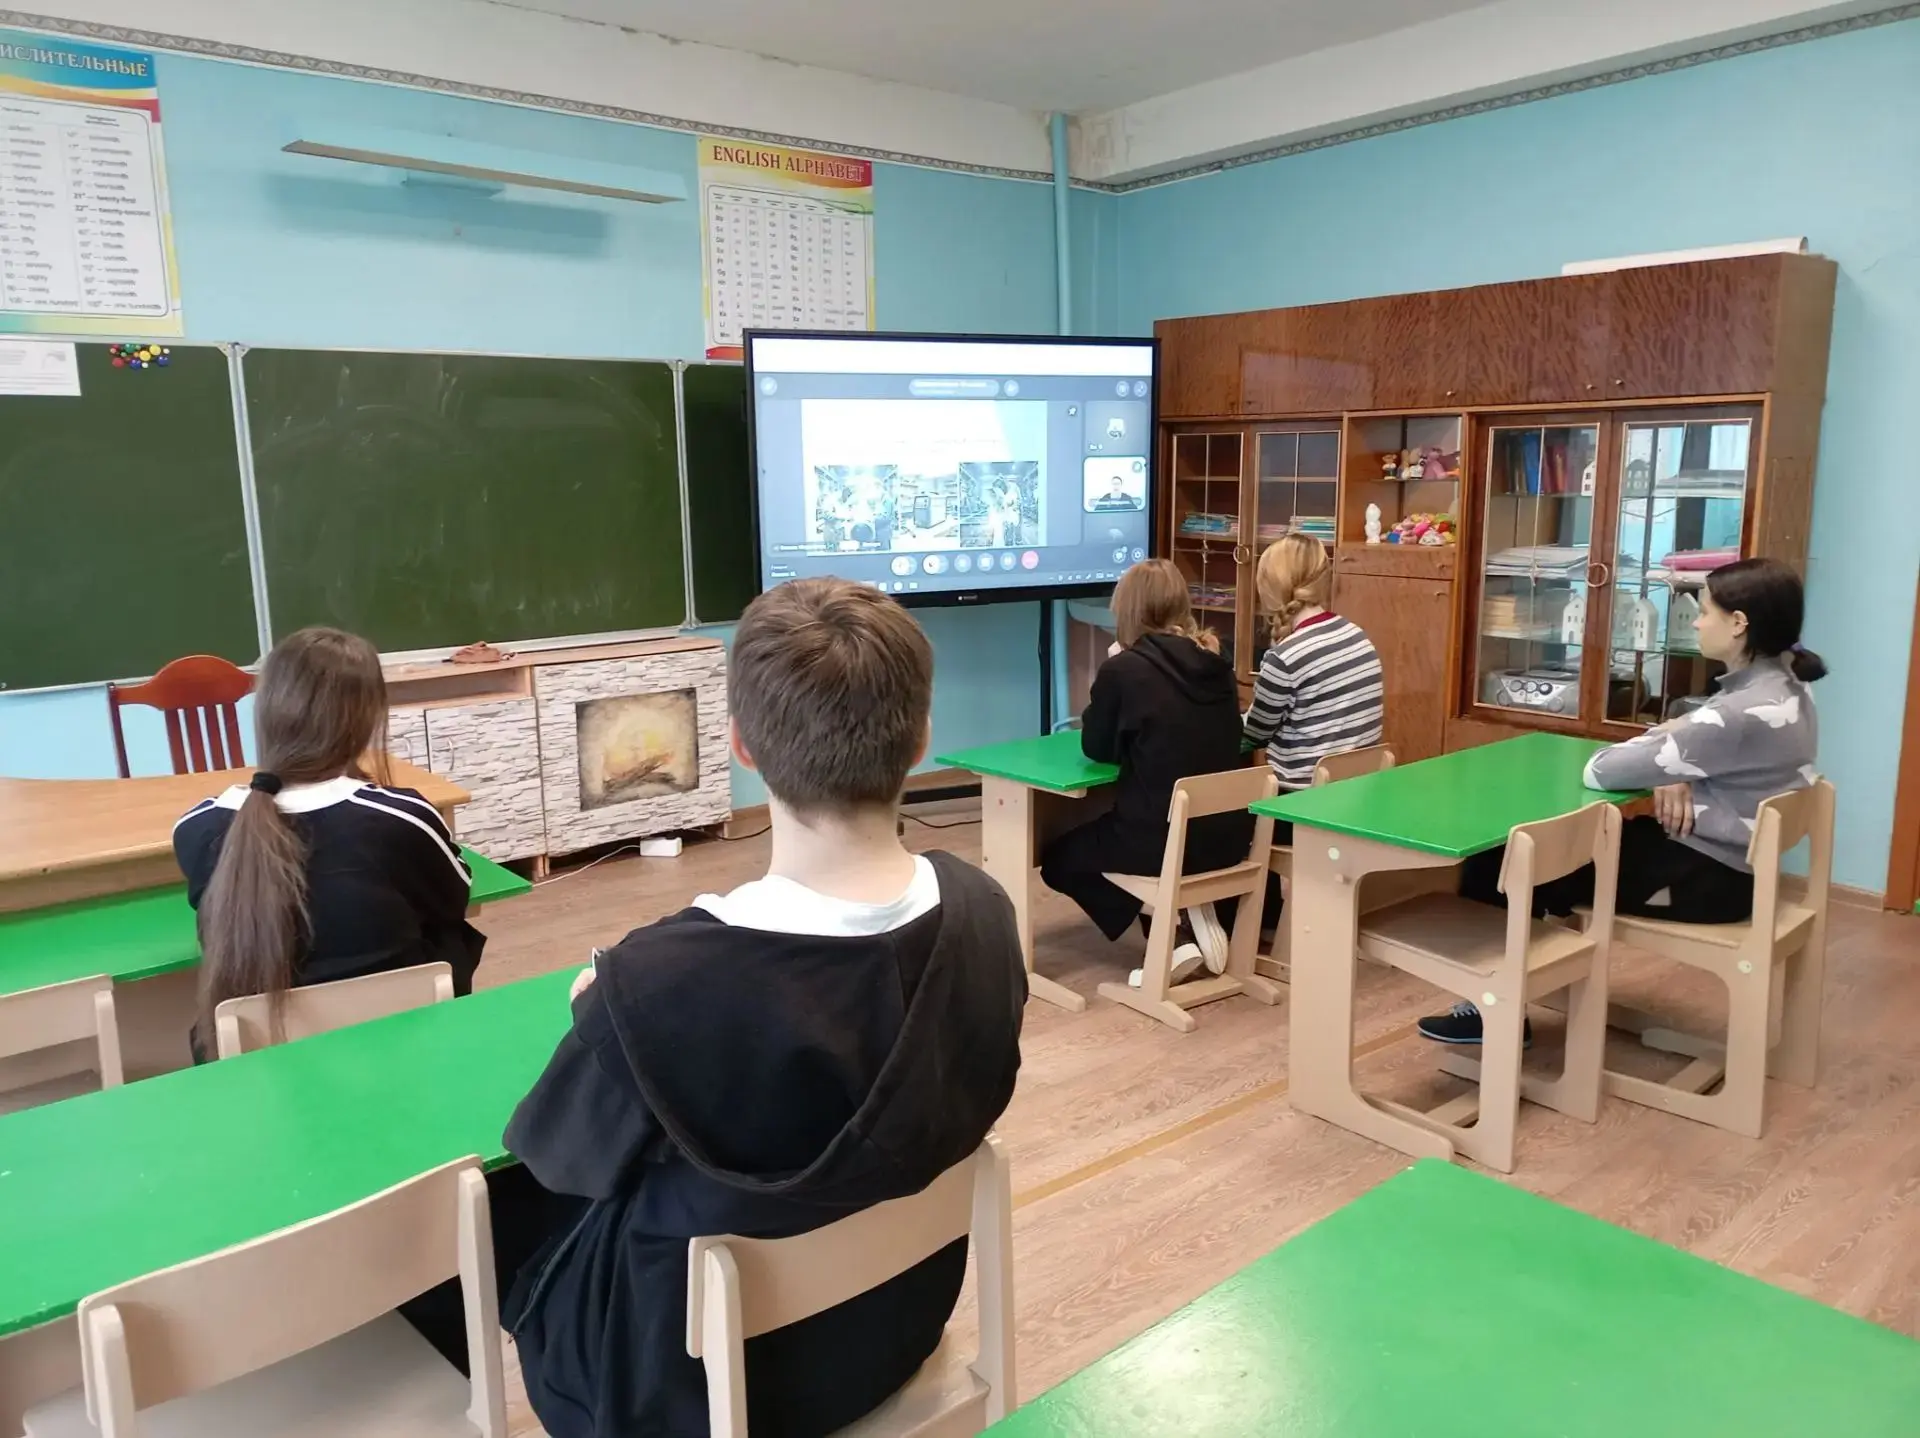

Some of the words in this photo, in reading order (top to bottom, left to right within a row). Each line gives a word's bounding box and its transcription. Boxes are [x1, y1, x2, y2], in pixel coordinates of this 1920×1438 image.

[0, 44, 148, 76] ИСЛИТЕЛЬНЫЕ
[713, 145, 780, 169] ENGLISH
[785, 156, 864, 182] ALPHABET
